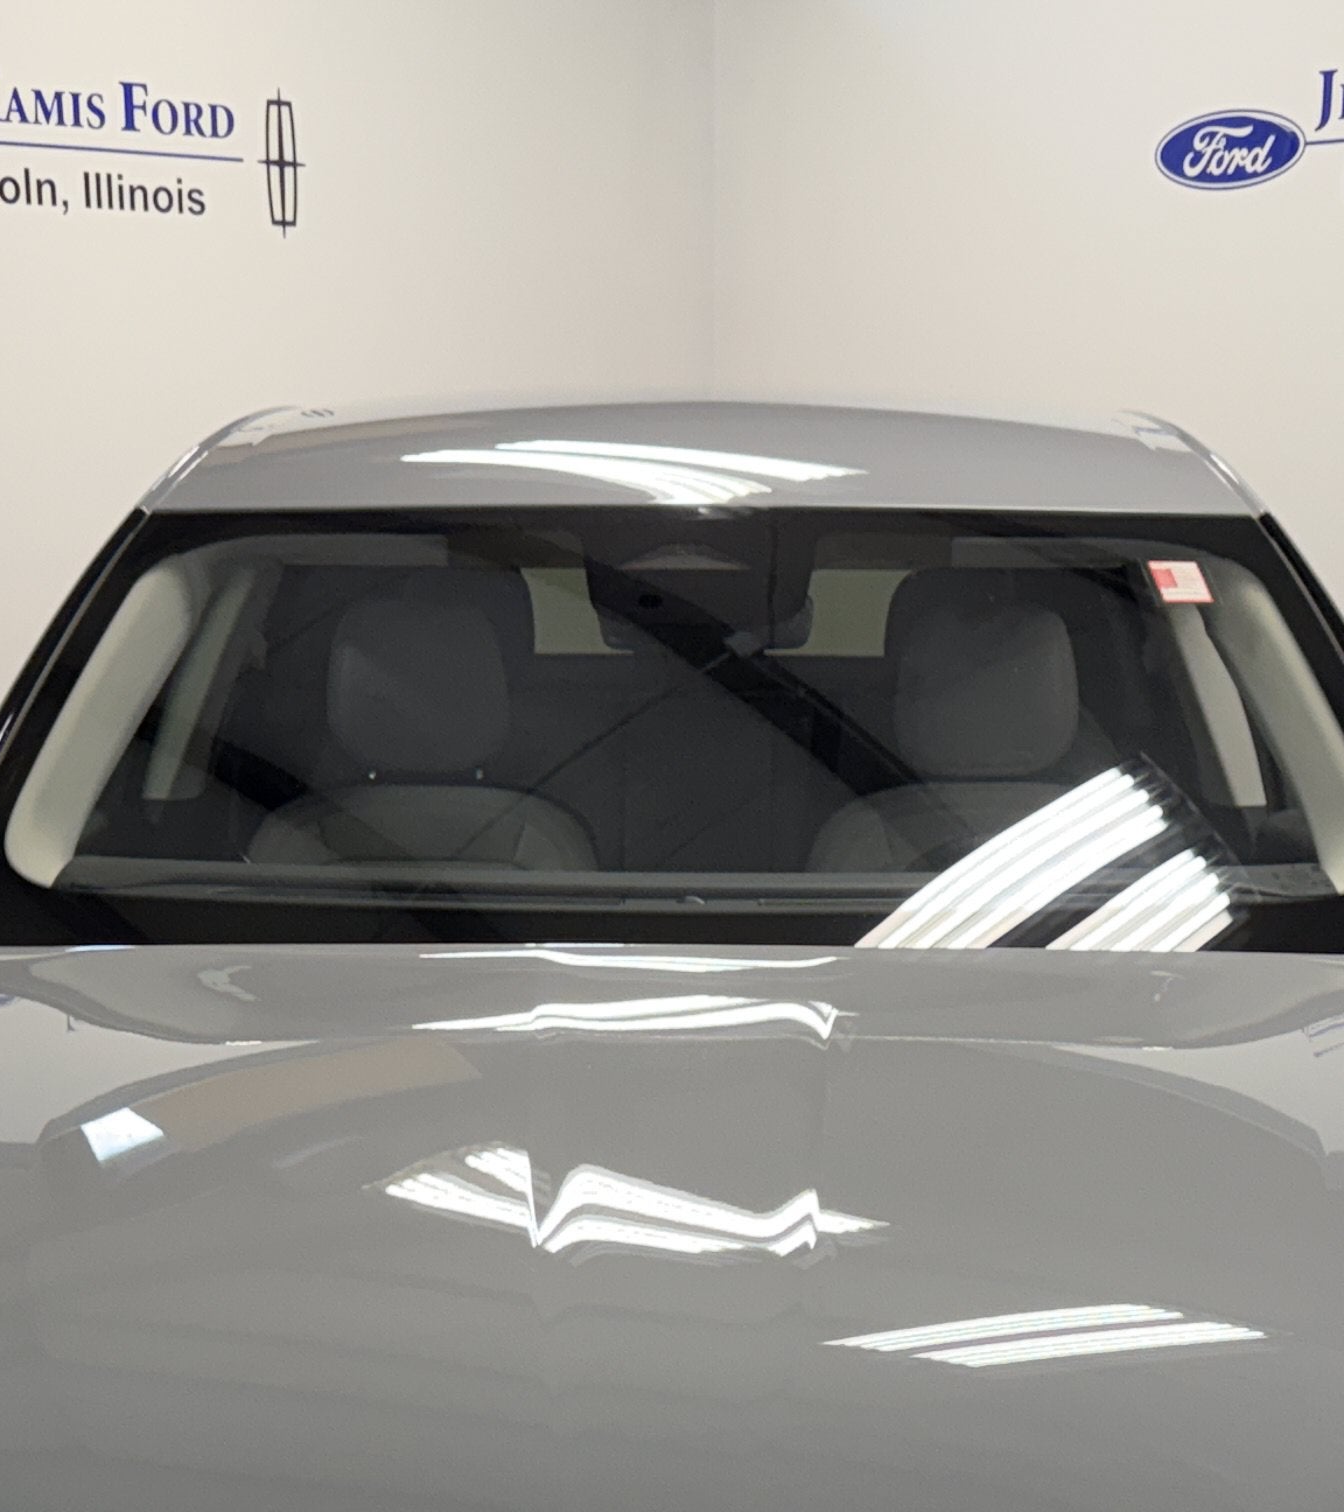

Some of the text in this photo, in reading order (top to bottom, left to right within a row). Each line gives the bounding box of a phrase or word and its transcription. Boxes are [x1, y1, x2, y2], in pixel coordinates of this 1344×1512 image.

[119, 81, 235, 139] FORD
[1183, 125, 1275, 177] Ford
[83, 171, 206, 216] Illinois
